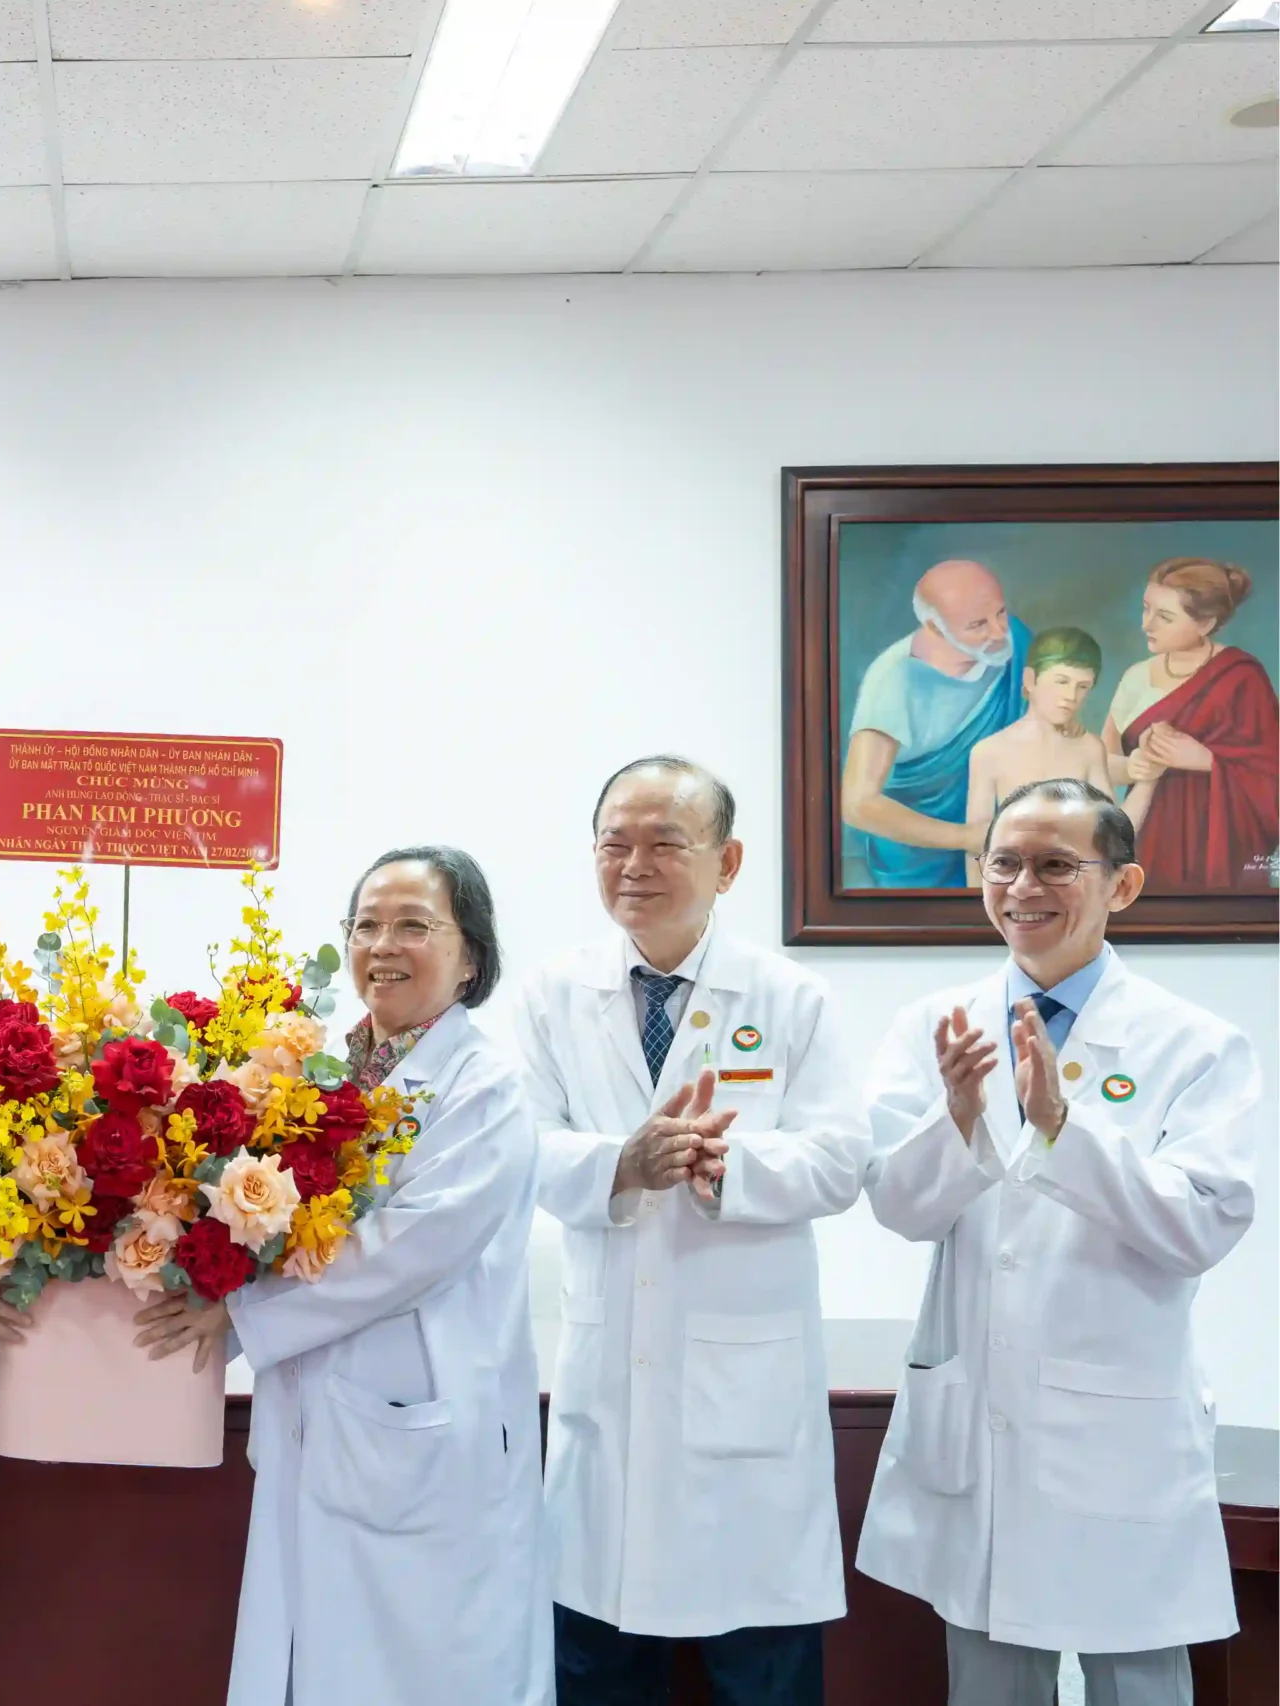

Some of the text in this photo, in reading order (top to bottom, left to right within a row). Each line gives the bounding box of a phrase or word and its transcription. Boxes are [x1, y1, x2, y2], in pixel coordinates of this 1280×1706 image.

[10, 744, 40, 755] THÀNH
[44, 744, 55, 756] ỦY
[65, 744, 80, 757] HỘI
[83, 744, 108, 757] ĐỒNG
[111, 745, 137, 758] NHÂN
[140, 747, 159, 759] DÂN
[183, 750, 201, 760] BAN
[9, 757, 19, 770] ỦY
[22, 760, 38, 770] BAN
[40, 758, 58, 772] MẶT
[59, 759, 80, 773] TRẬN
[95, 760, 117, 772] QUỐC
[119, 761, 137, 775] VIỆT
[139, 764, 157, 774] NAM
[159, 763, 187, 775] THÀNH
[189, 763, 206, 776] PHỐ
[221, 765, 235, 777] CHÍ
[238, 768, 259, 777] MINH
[76, 774, 189, 790] CHÚC MỪNG
[45, 789, 64, 799] ANH
[95, 791, 114, 800] LAO
[22, 802, 242, 828] PHAN KIM PHƯƠNG
[35, 837, 68, 850] NGÀY
[71, 840, 102, 853] THY
[150, 844, 178, 857] VIỆT
